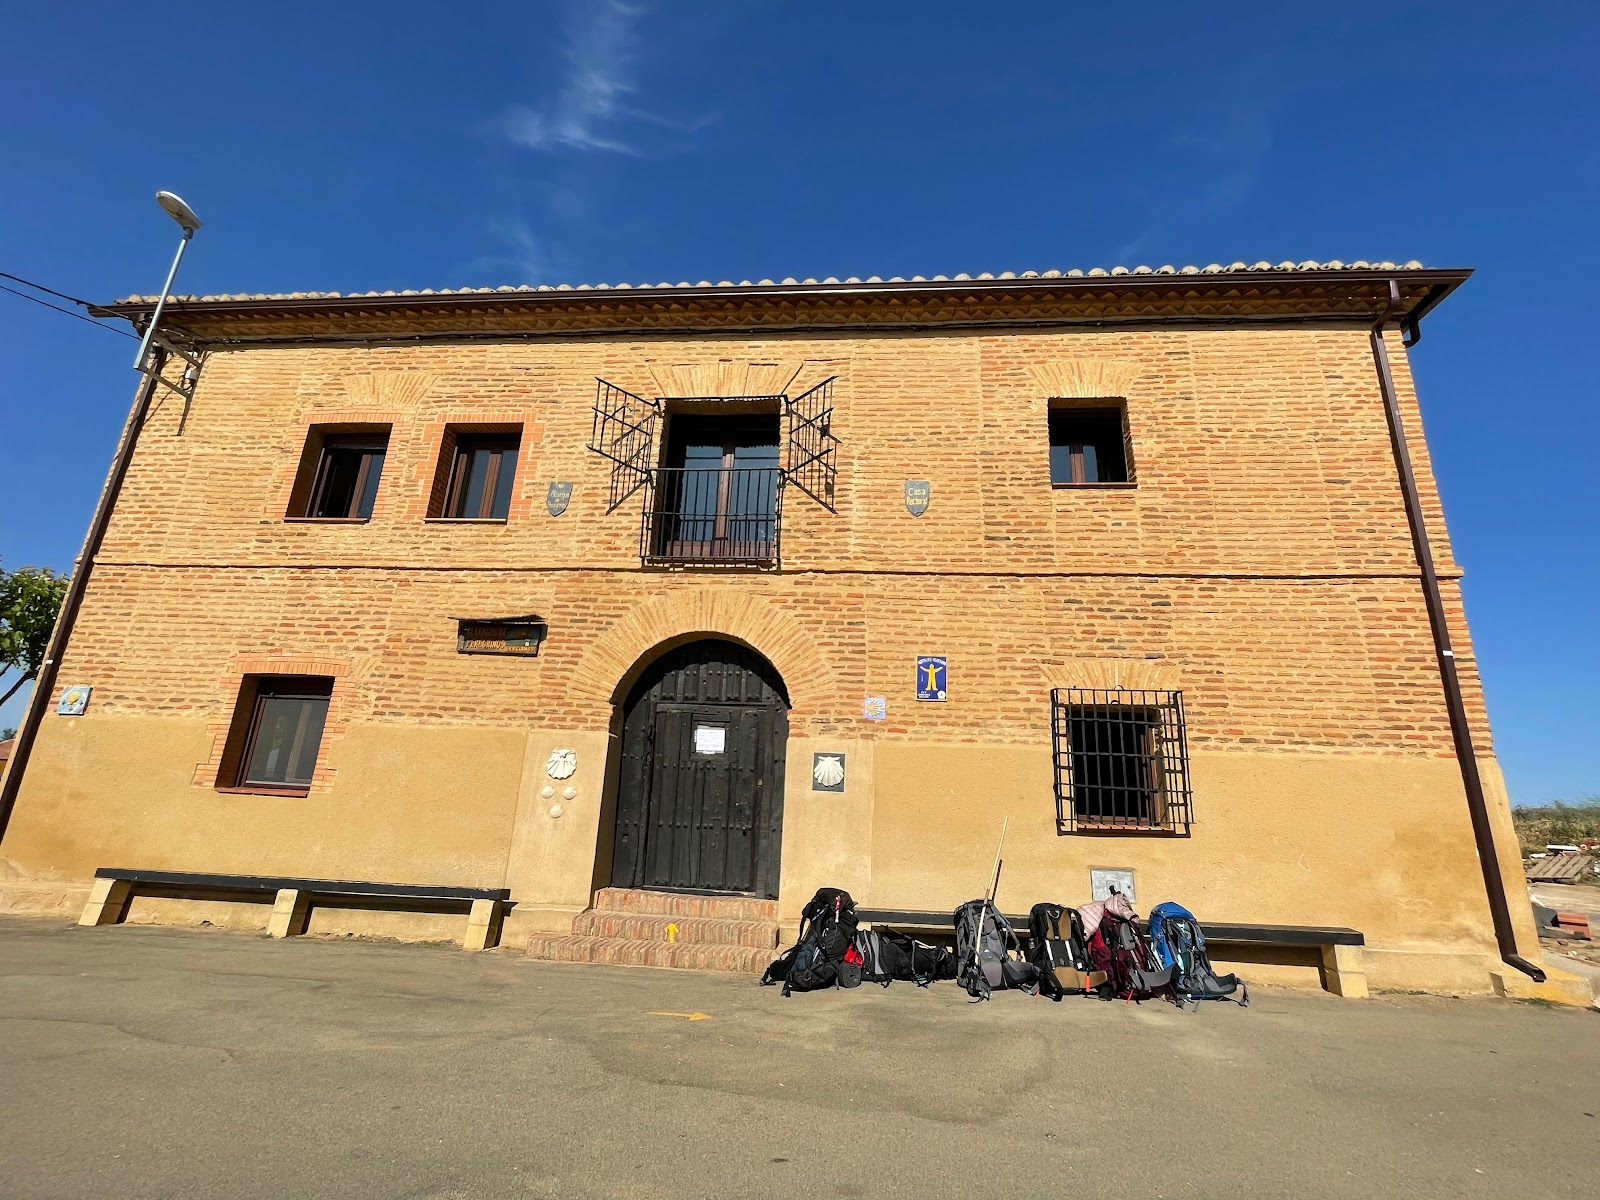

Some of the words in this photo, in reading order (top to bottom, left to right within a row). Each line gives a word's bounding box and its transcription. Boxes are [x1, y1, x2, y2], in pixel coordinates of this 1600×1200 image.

[908, 487, 926, 496] Casa
[906, 496, 928, 505] Rectoral
[499, 627, 508, 637] DE
